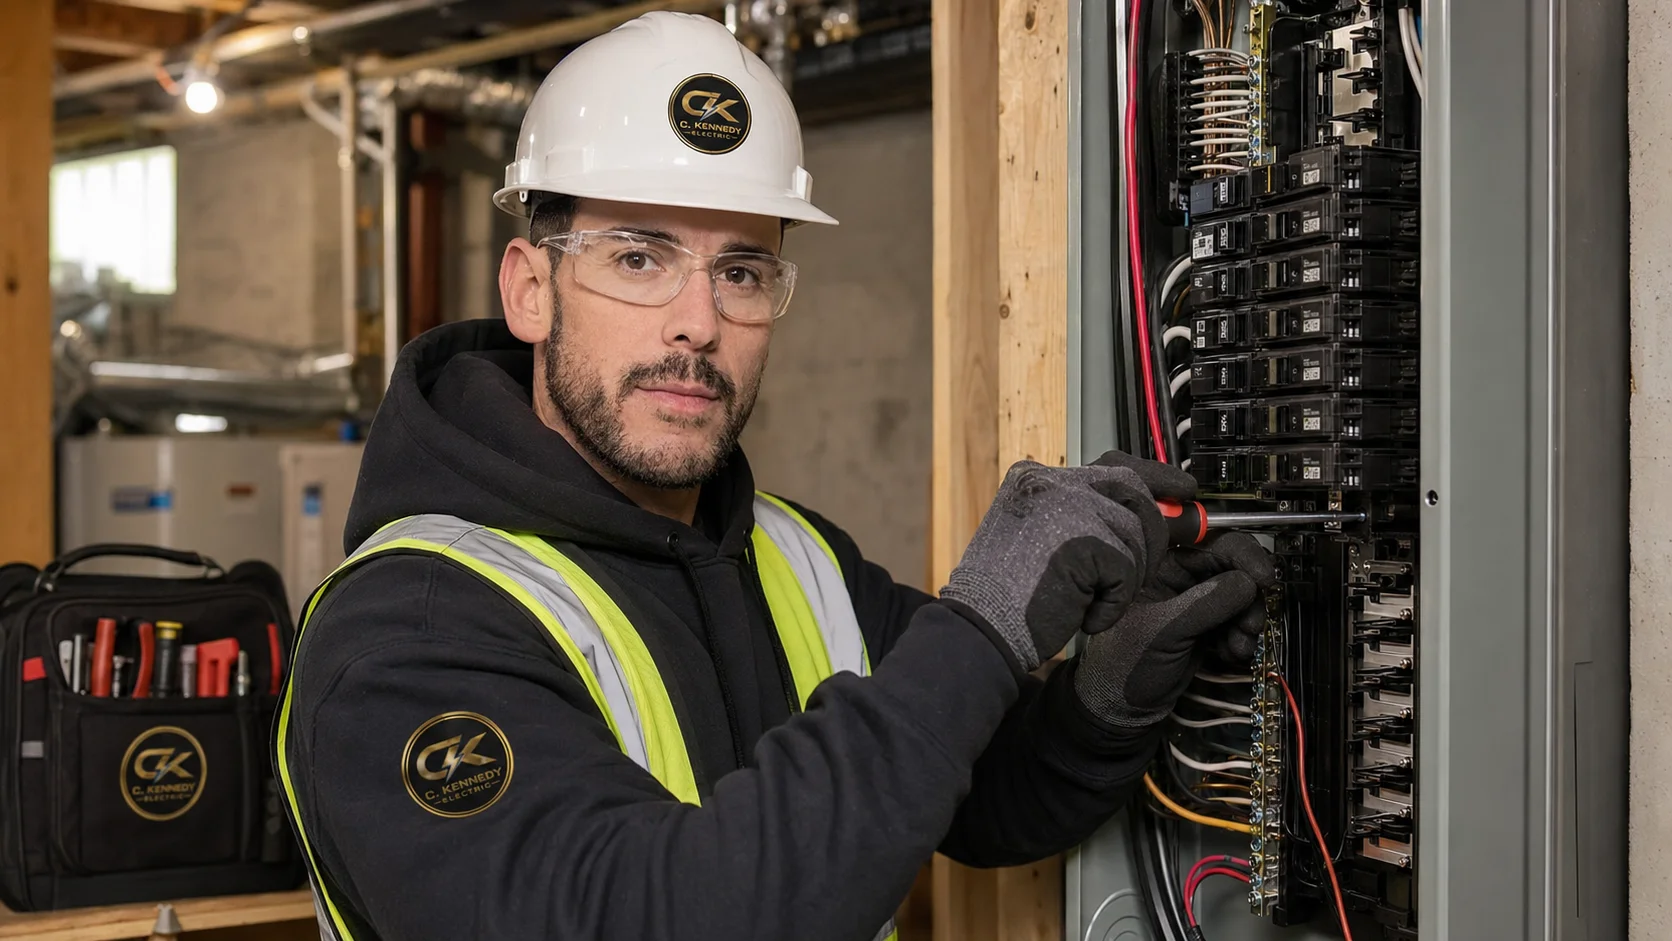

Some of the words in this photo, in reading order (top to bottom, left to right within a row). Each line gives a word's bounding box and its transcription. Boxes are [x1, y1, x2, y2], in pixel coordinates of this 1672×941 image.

[680, 120, 691, 129] C.
[694, 121, 742, 135] KENNEDY
[691, 130, 731, 140] ELECTRIC
[131, 786, 145, 795] C.
[147, 782, 195, 794] KENNEDY
[424, 790, 440, 801] C.
[441, 766, 502, 795] KENNEDY
[442, 781, 492, 804] ELECTRIC
